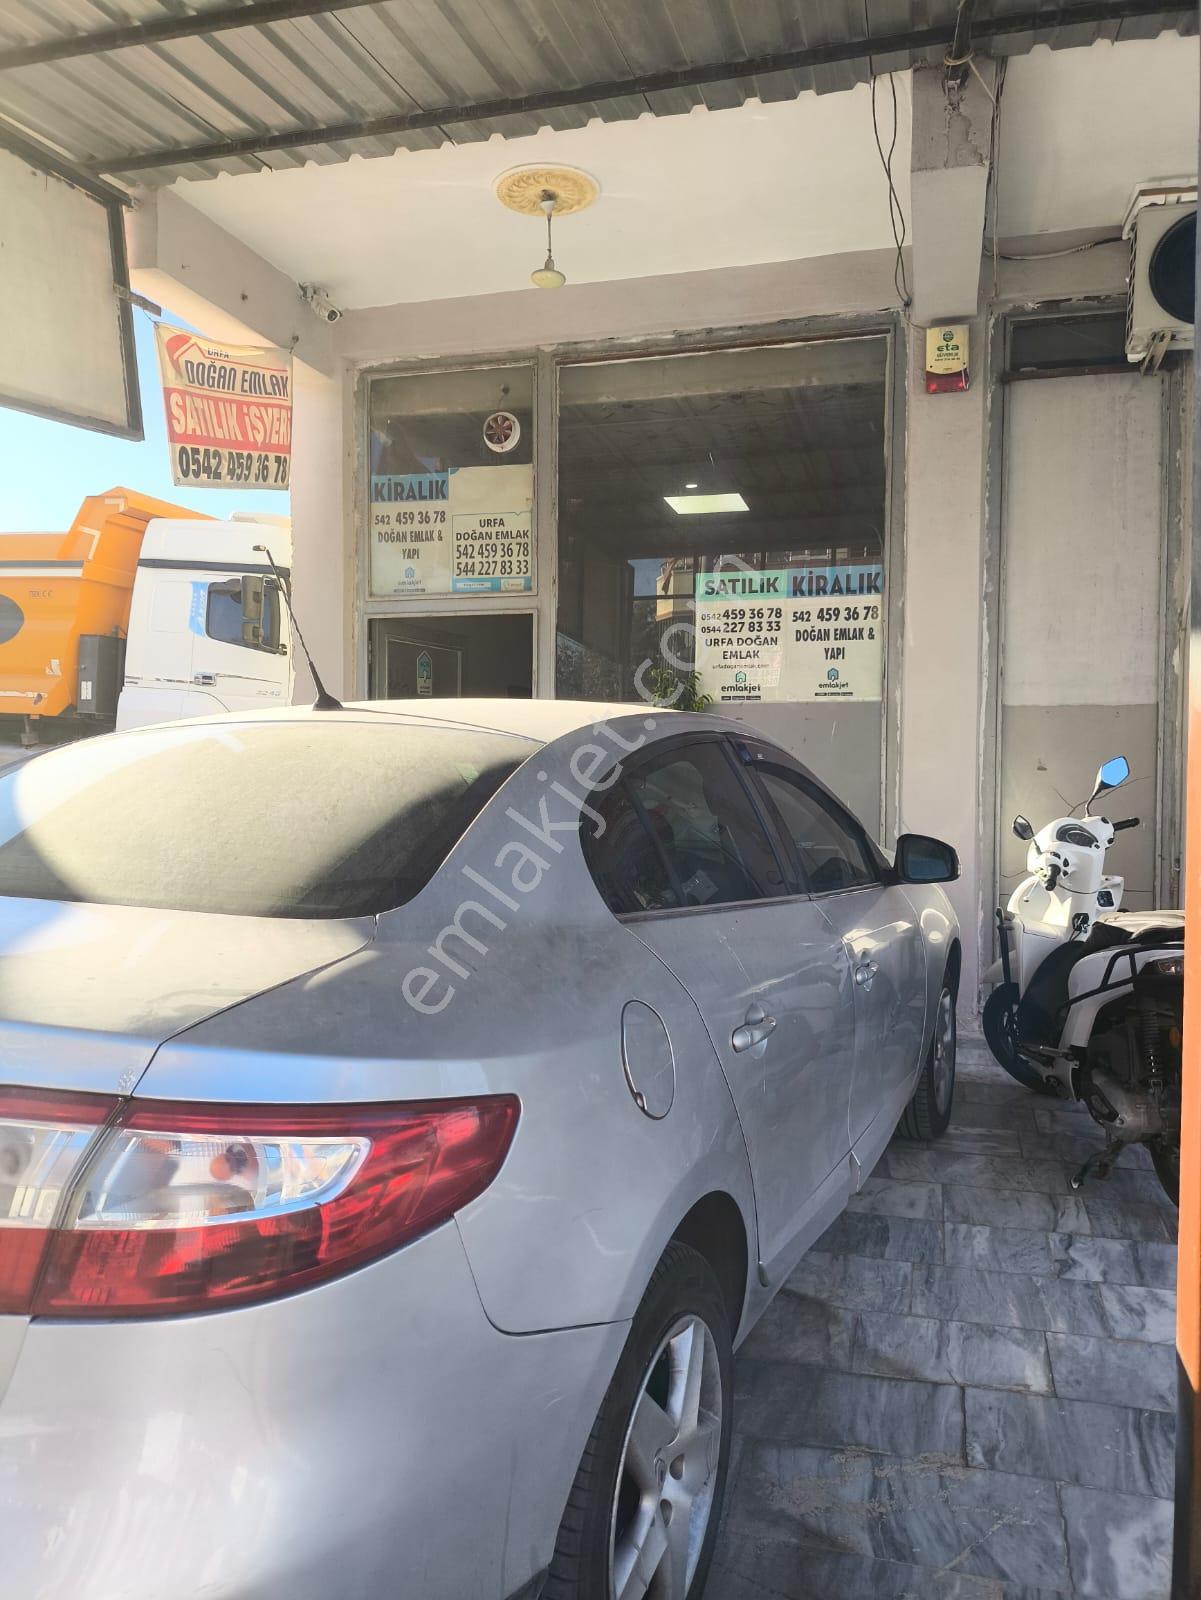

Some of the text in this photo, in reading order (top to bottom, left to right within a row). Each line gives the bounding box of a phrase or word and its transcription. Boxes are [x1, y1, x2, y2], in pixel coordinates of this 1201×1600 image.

[937, 343, 959, 352] eta
[185, 360, 288, 398] DOĞAN EMLAK
[170, 392, 243, 441] SATILIK
[178, 446, 288, 484] 0542 459 36 78
[375, 477, 446, 501] KİRALIK
[375, 510, 446, 525] 542 459 36 78
[479, 518, 505, 528] URFA
[378, 528, 443, 543] DOĞAN EMLAK &
[456, 529, 529, 541] DOĞAN EMLAK
[402, 548, 419, 559] YAPI
[456, 542, 529, 559] 542 459 36 78
[456, 560, 529, 576] 544 227 83 33
[705, 577, 779, 595] SATILIK
[792, 570, 881, 597] KİRALIK
[722, 608, 745, 619] 459
[749, 608, 764, 619] 36
[766, 608, 782, 619] 78
[792, 605, 879, 622] 542 459 36 78
[723, 621, 745, 633] 227
[748, 621, 763, 632] 83
[766, 620, 781, 632] 33
[795, 625, 875, 642] DOĞAN EMLAK &
[705, 635, 778, 647] URFA DOĞAN
[723, 650, 760, 660] EMLAK
[824, 647, 845, 660] YAPI
[721, 683, 761, 693] emlakjet
